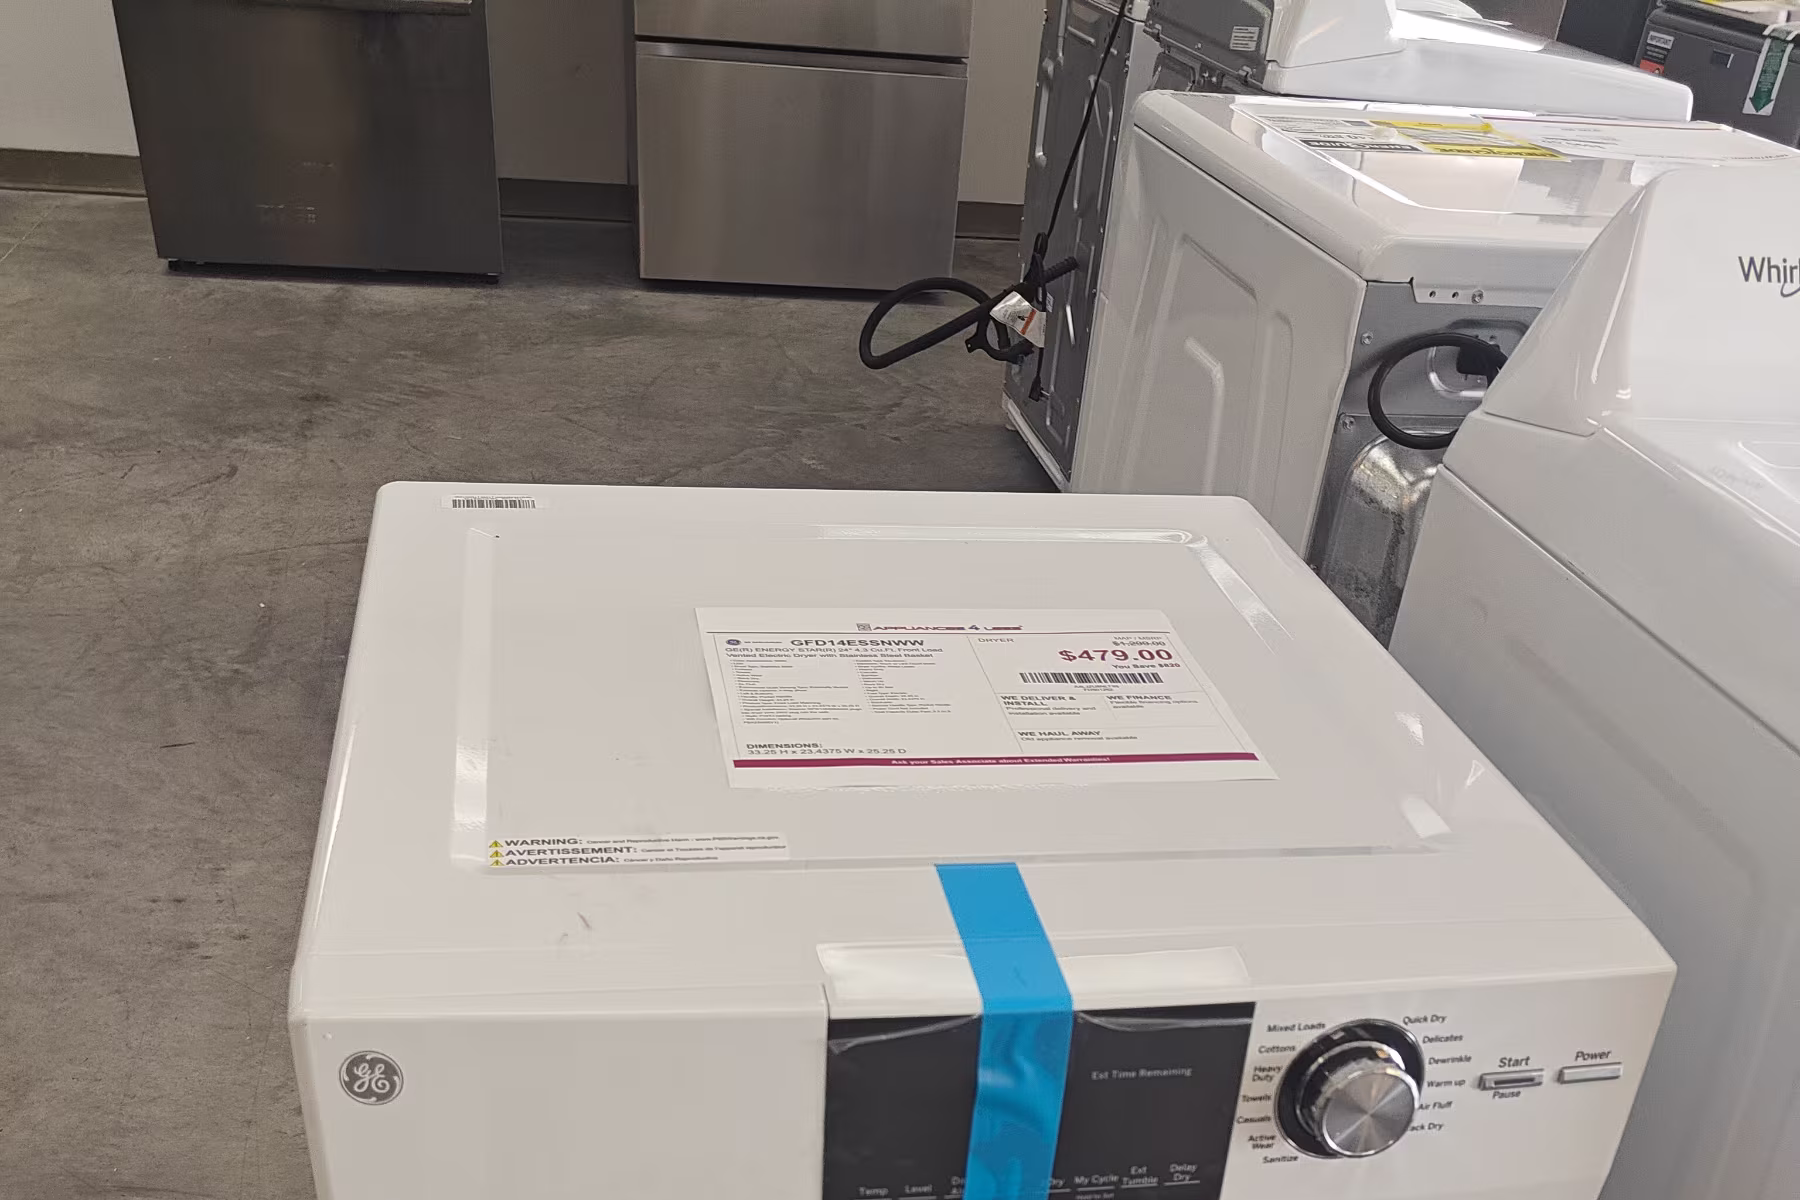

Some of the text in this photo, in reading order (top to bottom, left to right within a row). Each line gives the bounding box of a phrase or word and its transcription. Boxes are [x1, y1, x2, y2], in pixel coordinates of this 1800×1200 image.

[790, 639, 924, 647] GFD14ESSNWW
[1058, 649, 1173, 662] $479.00
[504, 837, 583, 847] WARNING:
[505, 846, 638, 857] AVERTISSEMENT:
[506, 856, 620, 866] ADVERTENCIA:
[1402, 1014, 1447, 1026] Quick Dry
[1266, 1022, 1326, 1032] Mixed Loads
[1422, 1034, 1464, 1044] Delicates
[1258, 1045, 1296, 1054] Cottons
[1428, 1054, 1472, 1065] Dewrinkle
[1574, 1050, 1612, 1062] Power
[1498, 1055, 1531, 1068] Start
[1112, 1069, 1137, 1079] Time
[1138, 1067, 1193, 1078] Remaining
[1253, 1065, 1282, 1074] Heavy
[1251, 1074, 1274, 1083] Duty
[1427, 1079, 1466, 1088] Warm up
[1242, 1094, 1272, 1102] Towels
[1492, 1090, 1522, 1100] Pause
[1432, 1100, 1453, 1109] Fluff
[1236, 1115, 1271, 1124] Casuals
[1409, 1122, 1445, 1132] ack Dry
[1262, 1155, 1299, 1164] Sanitize
[1169, 1163, 1198, 1174] Delay
[1074, 1174, 1120, 1185] My Cycle
[1122, 1175, 1159, 1185] Tumble
[1173, 1172, 1191, 1182] Dry
[859, 1186, 889, 1197] Temp
